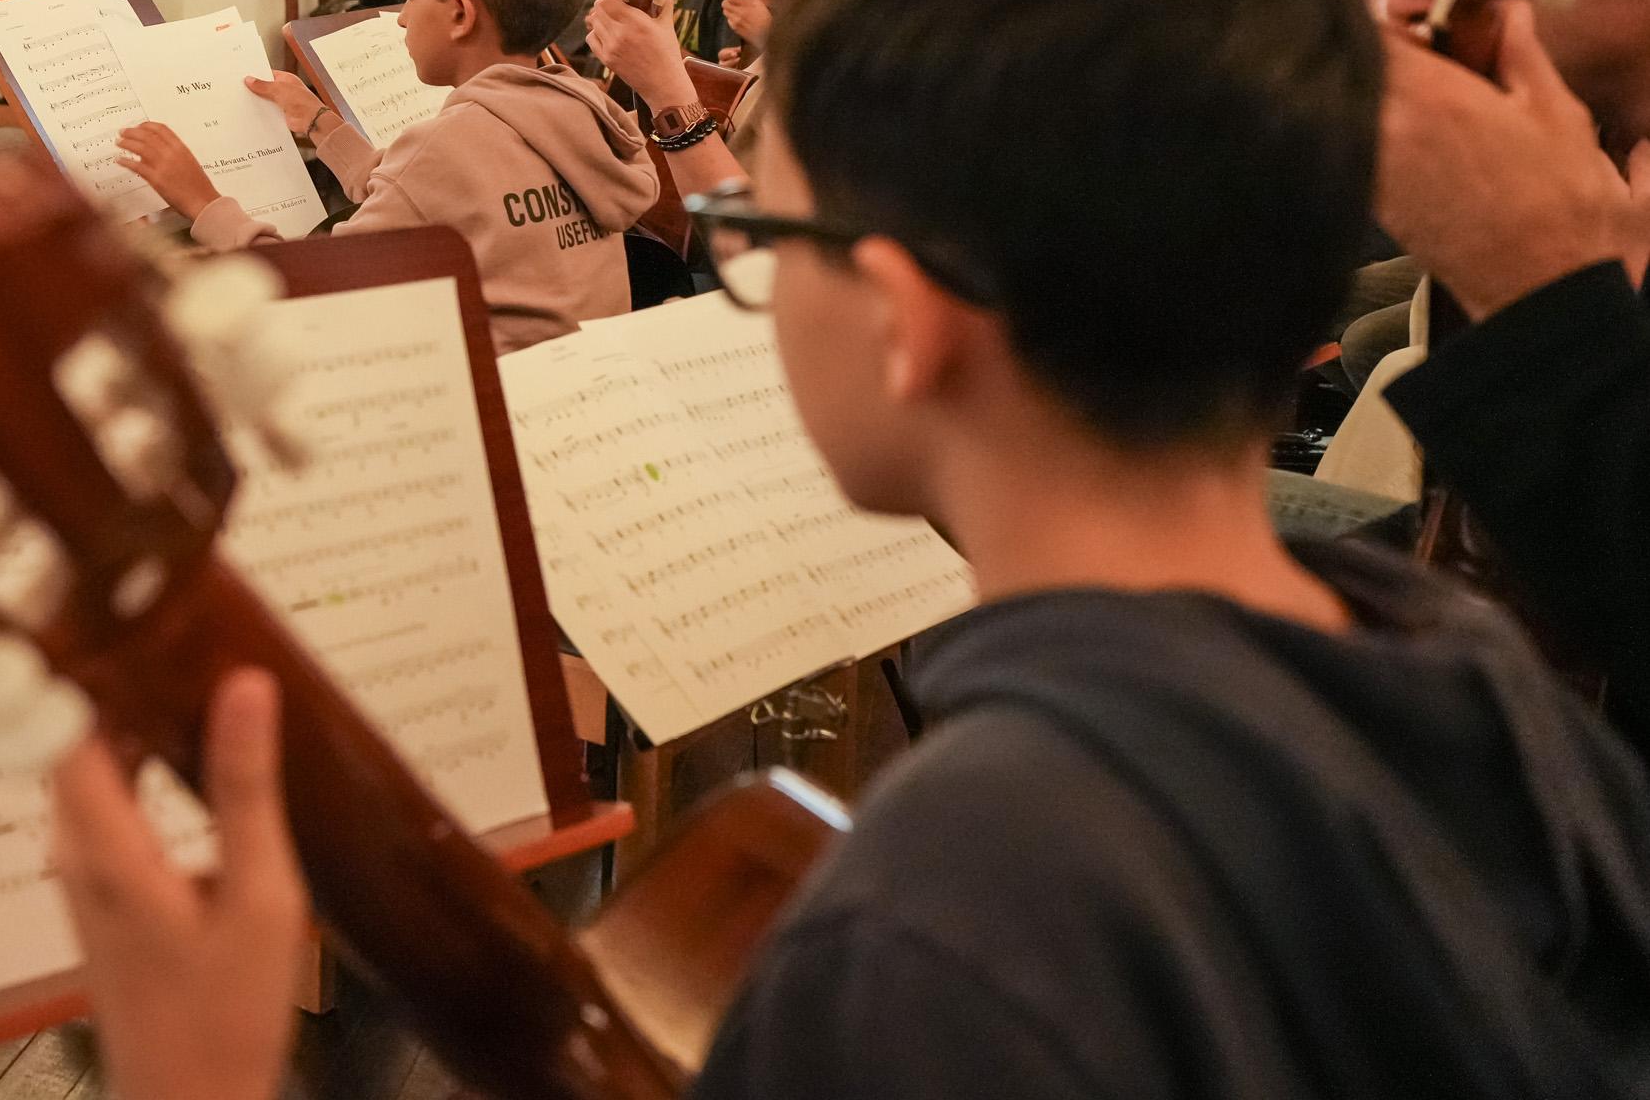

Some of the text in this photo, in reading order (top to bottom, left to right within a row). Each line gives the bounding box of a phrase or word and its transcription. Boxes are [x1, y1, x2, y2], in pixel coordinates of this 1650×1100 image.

[176, 81, 212, 95] My Way
[256, 145, 284, 158] Thibaut
